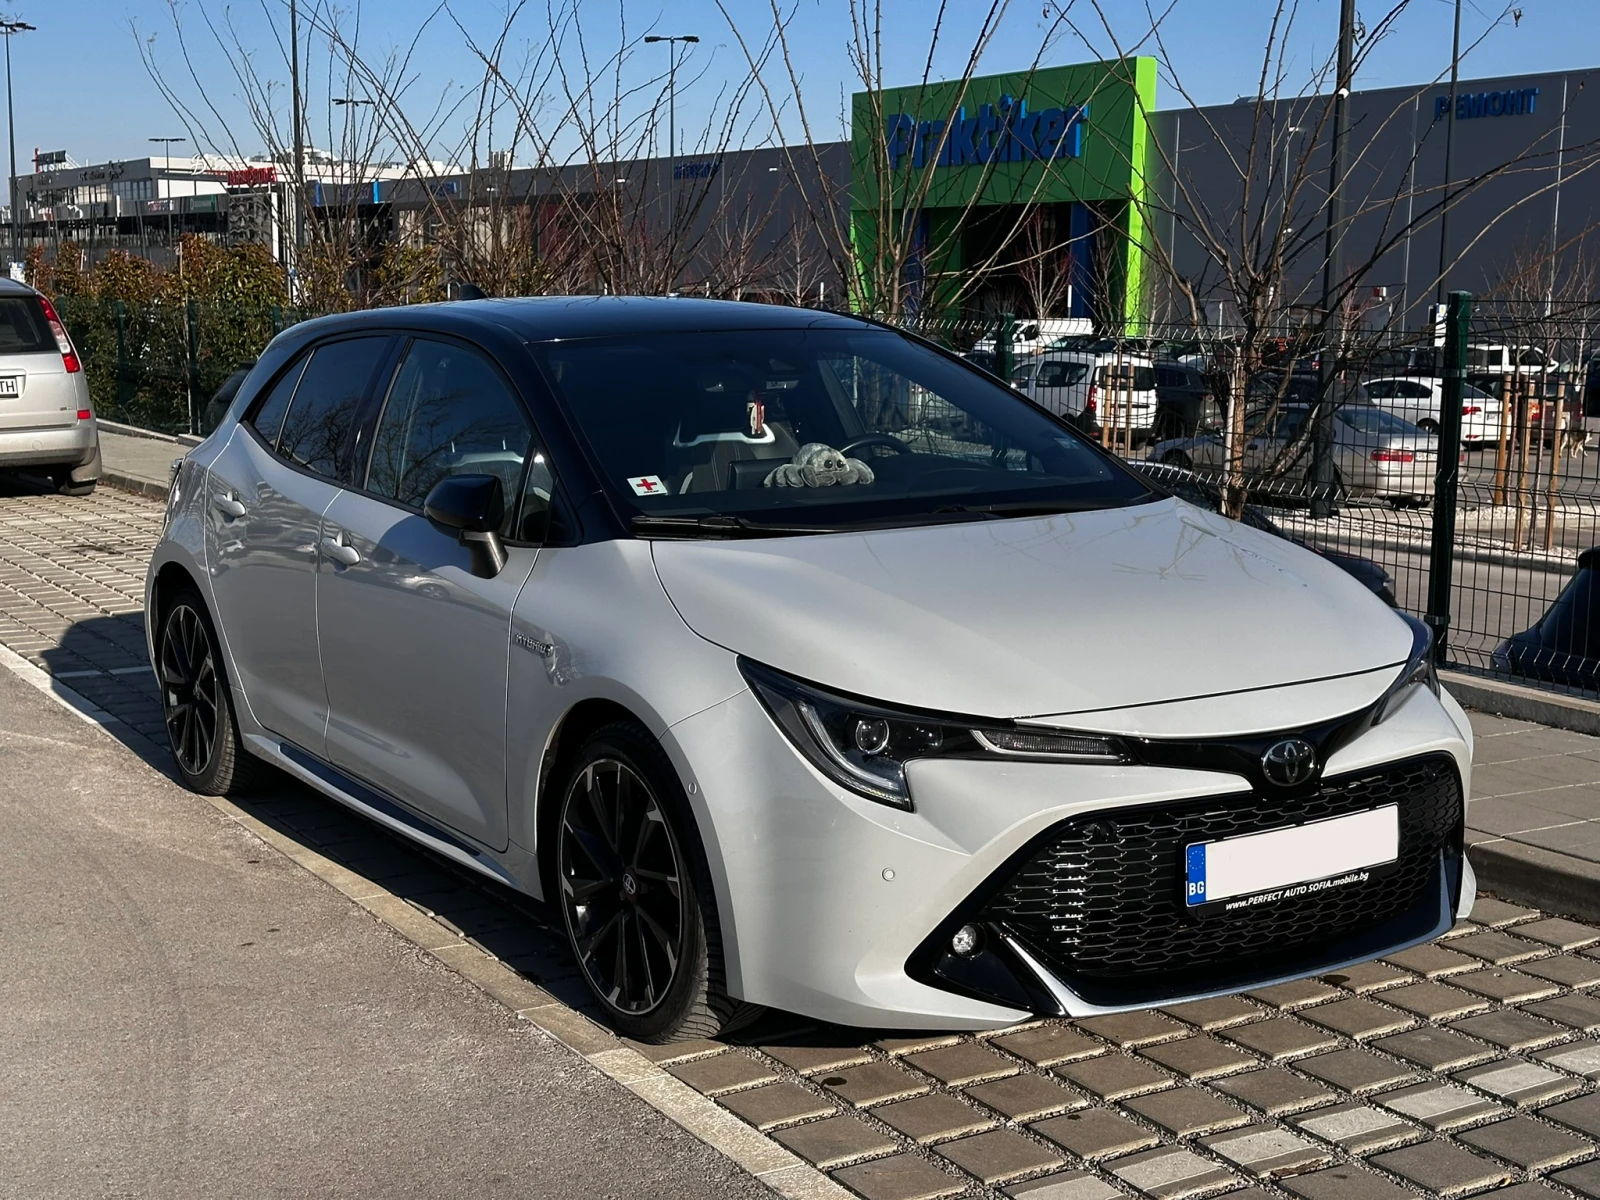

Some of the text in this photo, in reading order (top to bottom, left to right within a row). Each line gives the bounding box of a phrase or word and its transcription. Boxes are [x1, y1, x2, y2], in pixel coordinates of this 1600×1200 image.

[887, 94, 1088, 170] Praktiker
[1188, 881, 1205, 896] BG
[1284, 885, 1306, 898] AUTO
